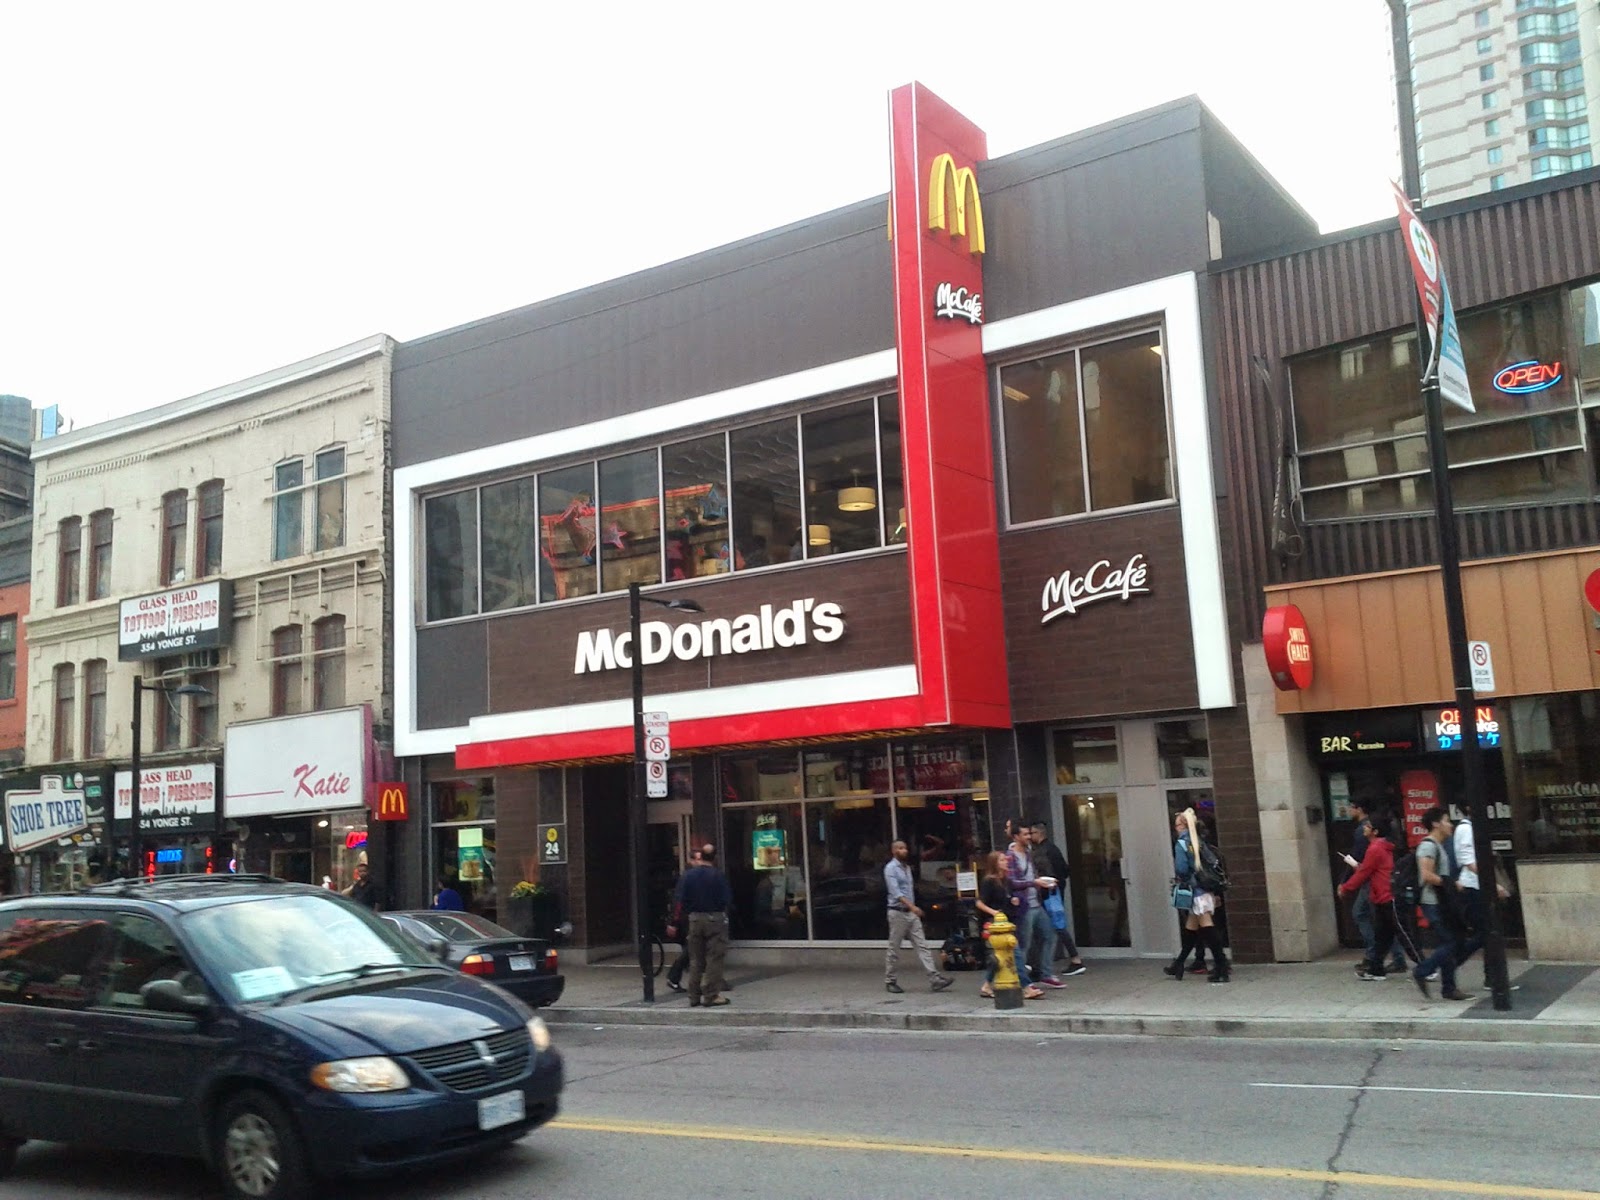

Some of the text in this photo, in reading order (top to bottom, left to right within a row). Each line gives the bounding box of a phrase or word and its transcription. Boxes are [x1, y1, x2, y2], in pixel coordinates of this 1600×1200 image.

[937, 283, 983, 323] McCafé
[1498, 362, 1560, 388] OPEN
[1041, 553, 1150, 623] McCafé
[139, 590, 198, 611] GLASS HEAD
[140, 643, 155, 653] 354
[157, 637, 184, 649] YONGE
[574, 598, 844, 675] McDonald's
[1288, 627, 1306, 642] SWISS
[1286, 639, 1310, 665] CHALET
[1320, 736, 1352, 753] BAR
[139, 769, 193, 785] LASS HEAD
[293, 763, 351, 799] Katie
[10, 799, 84, 836] SHOE TREE
[139, 820, 151, 829] 54
[152, 816, 180, 828] YONGE
[545, 842, 560, 855] 24
